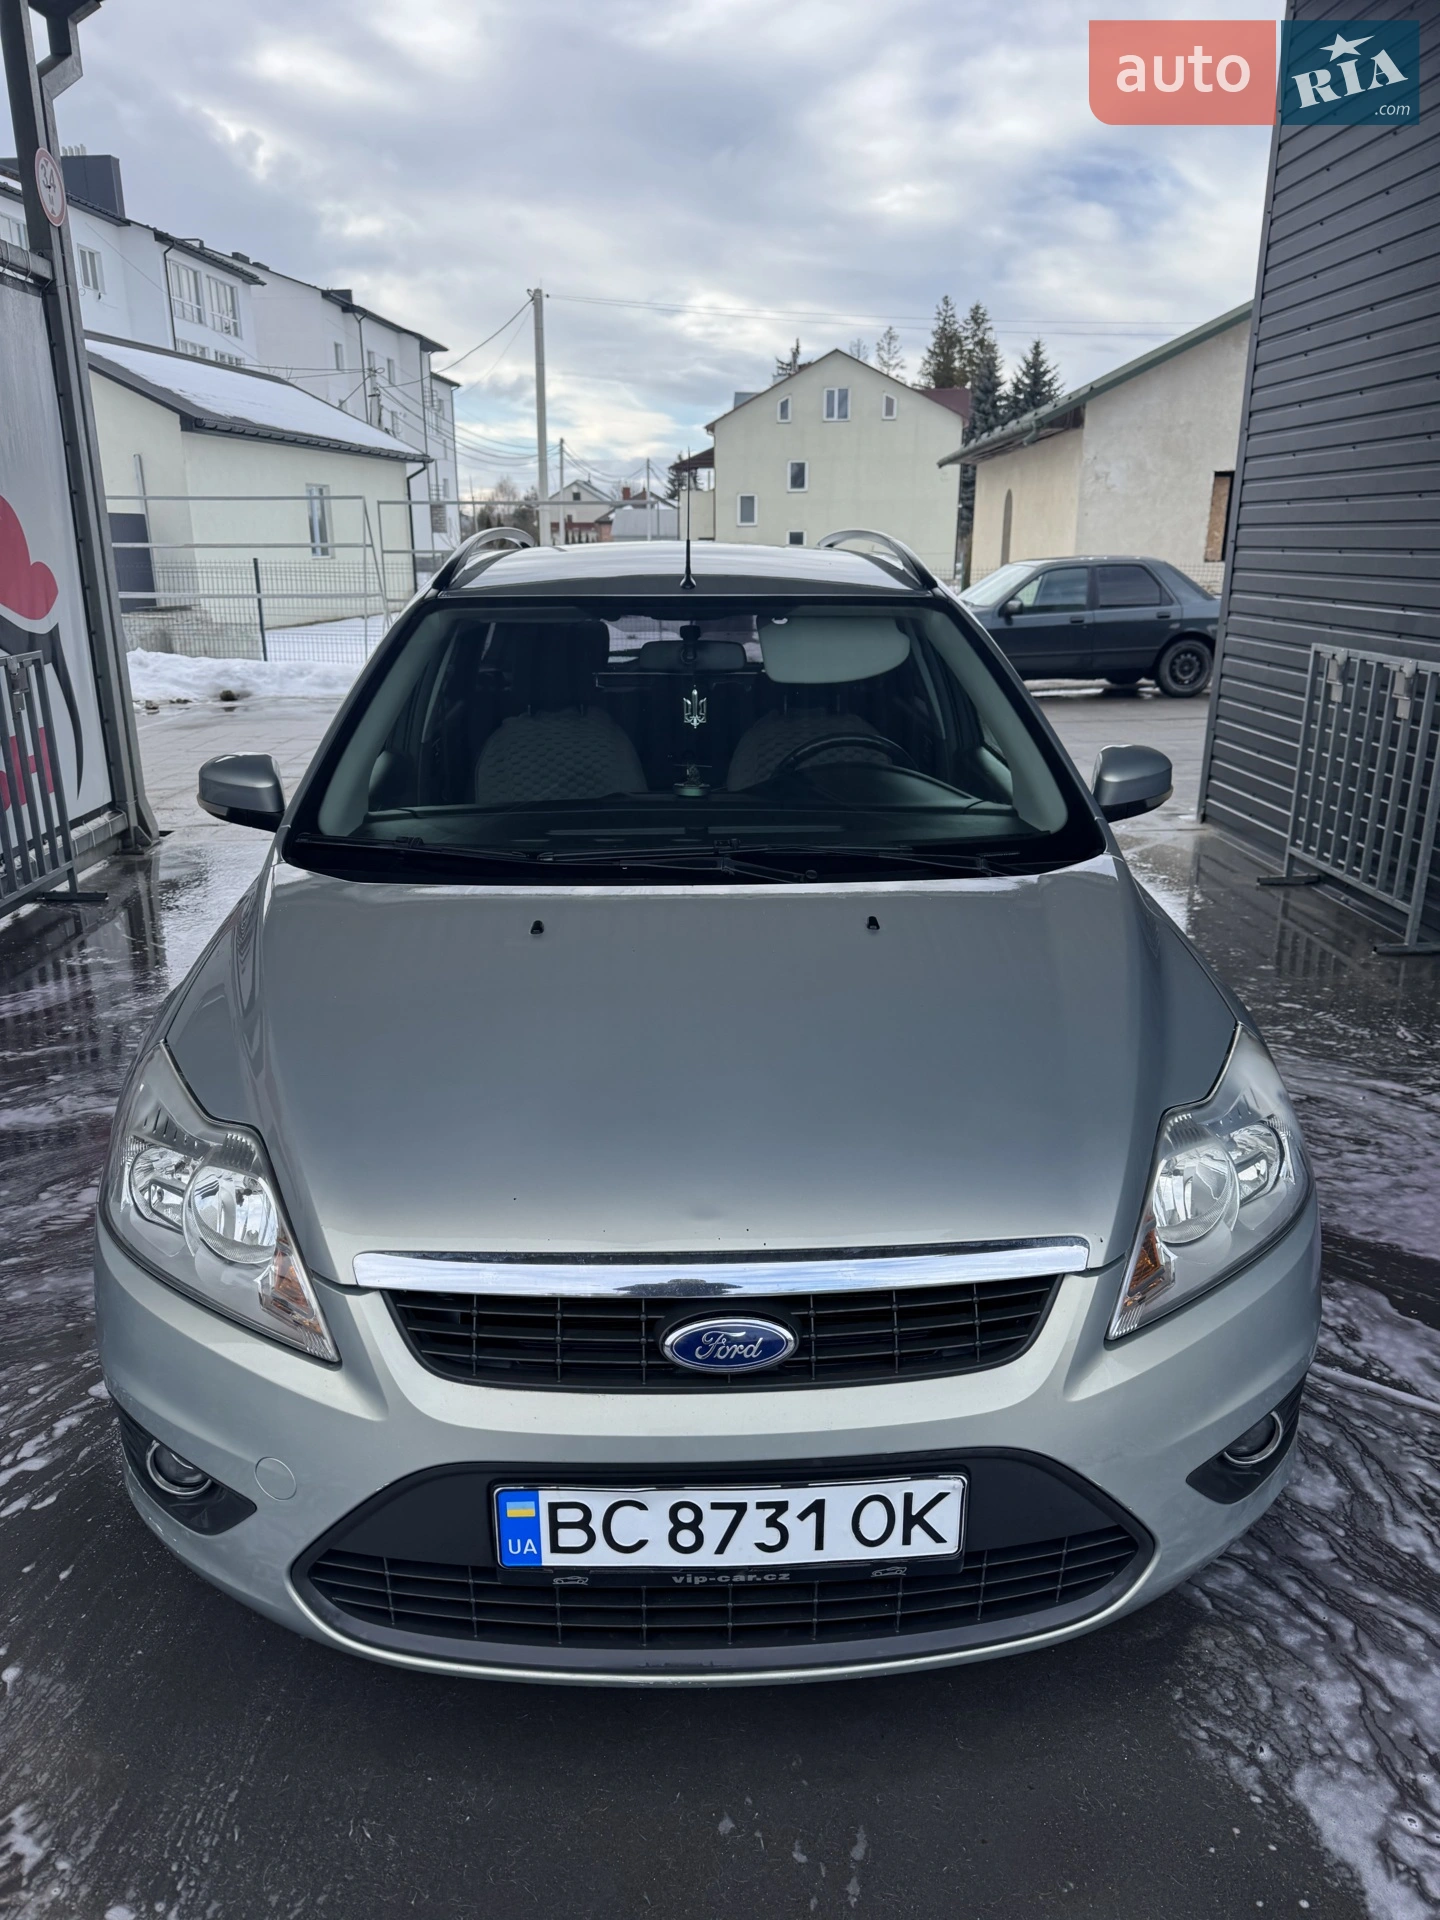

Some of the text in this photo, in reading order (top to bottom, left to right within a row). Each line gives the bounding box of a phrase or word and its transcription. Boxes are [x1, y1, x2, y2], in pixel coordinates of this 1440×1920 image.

[694, 1330, 763, 1359] Ford
[547, 1491, 951, 1555] BC 8731 OK
[508, 1539, 537, 1554] UA
[671, 1573, 791, 1585] vip-car.cz
